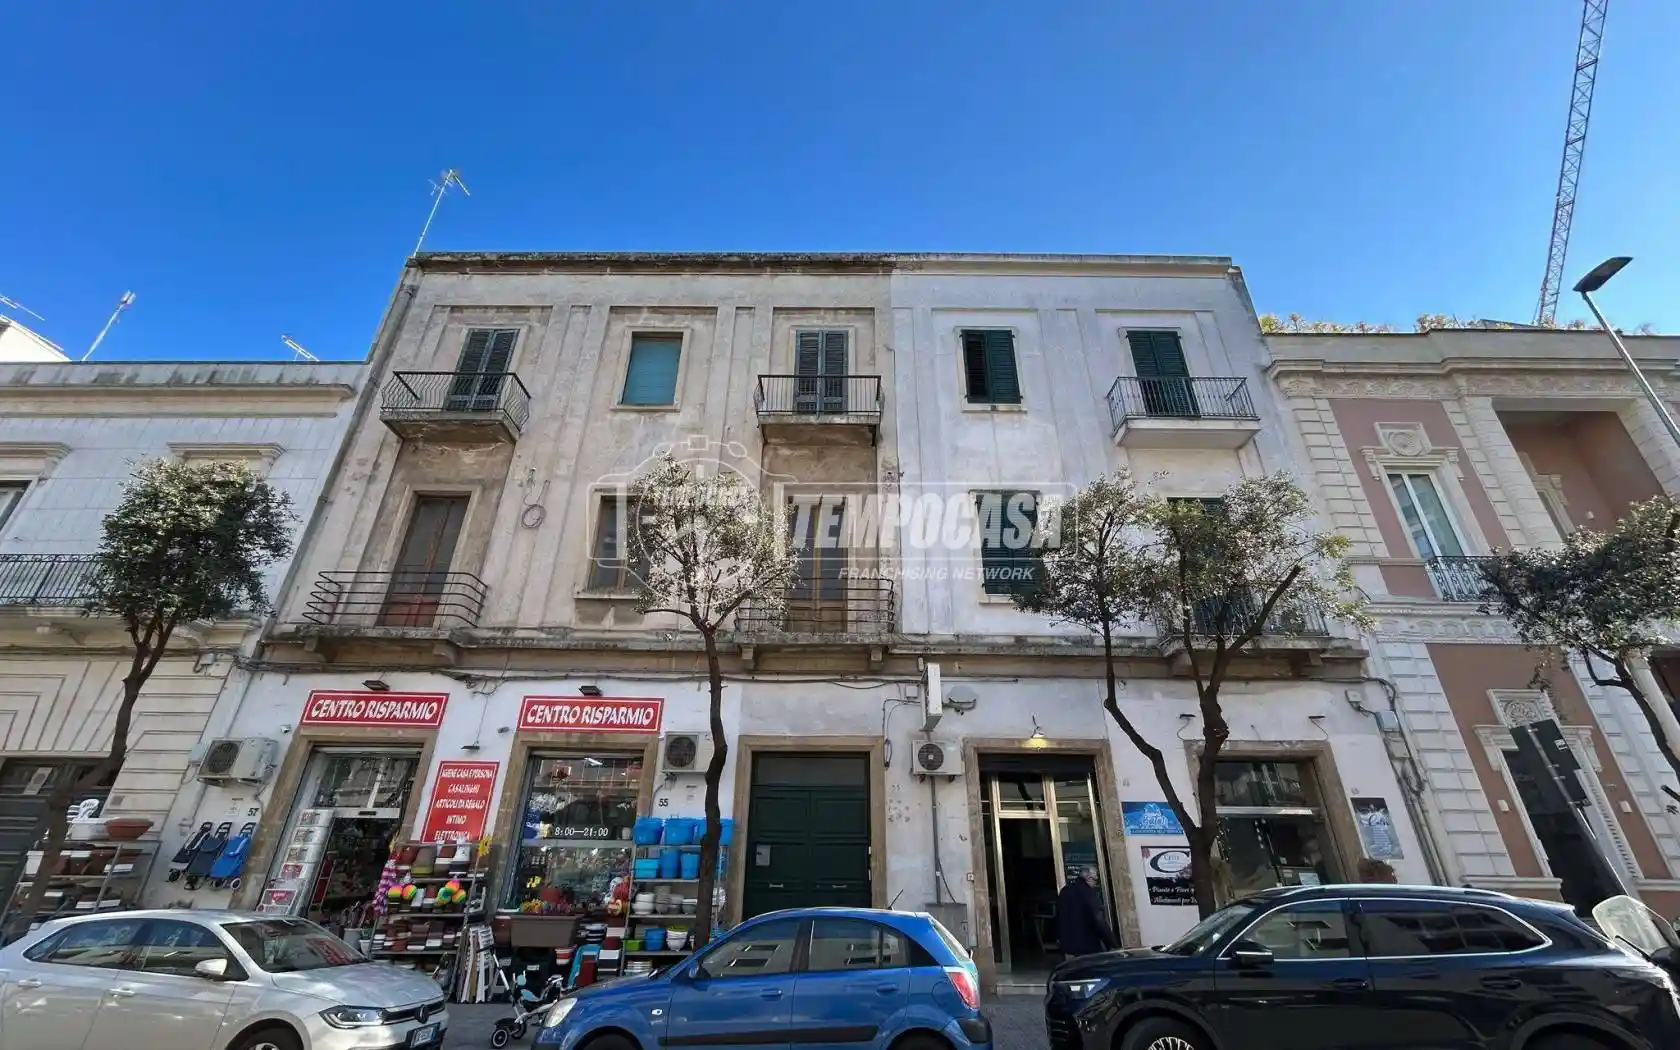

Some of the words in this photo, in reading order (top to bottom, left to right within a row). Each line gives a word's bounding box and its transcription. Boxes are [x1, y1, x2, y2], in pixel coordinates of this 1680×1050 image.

[311, 699, 365, 718] CENTRO
[364, 700, 438, 720] RISPARMIO
[527, 705, 580, 724] CENTRO
[581, 706, 654, 726] RISPARMIO
[448, 784, 480, 794] CASALINGHI
[435, 799, 458, 808] ARTICOLI
[465, 799, 486, 810] REGALO
[658, 798, 669, 807] 55
[247, 807, 260, 816] 57
[445, 815, 467, 824] INTIMO
